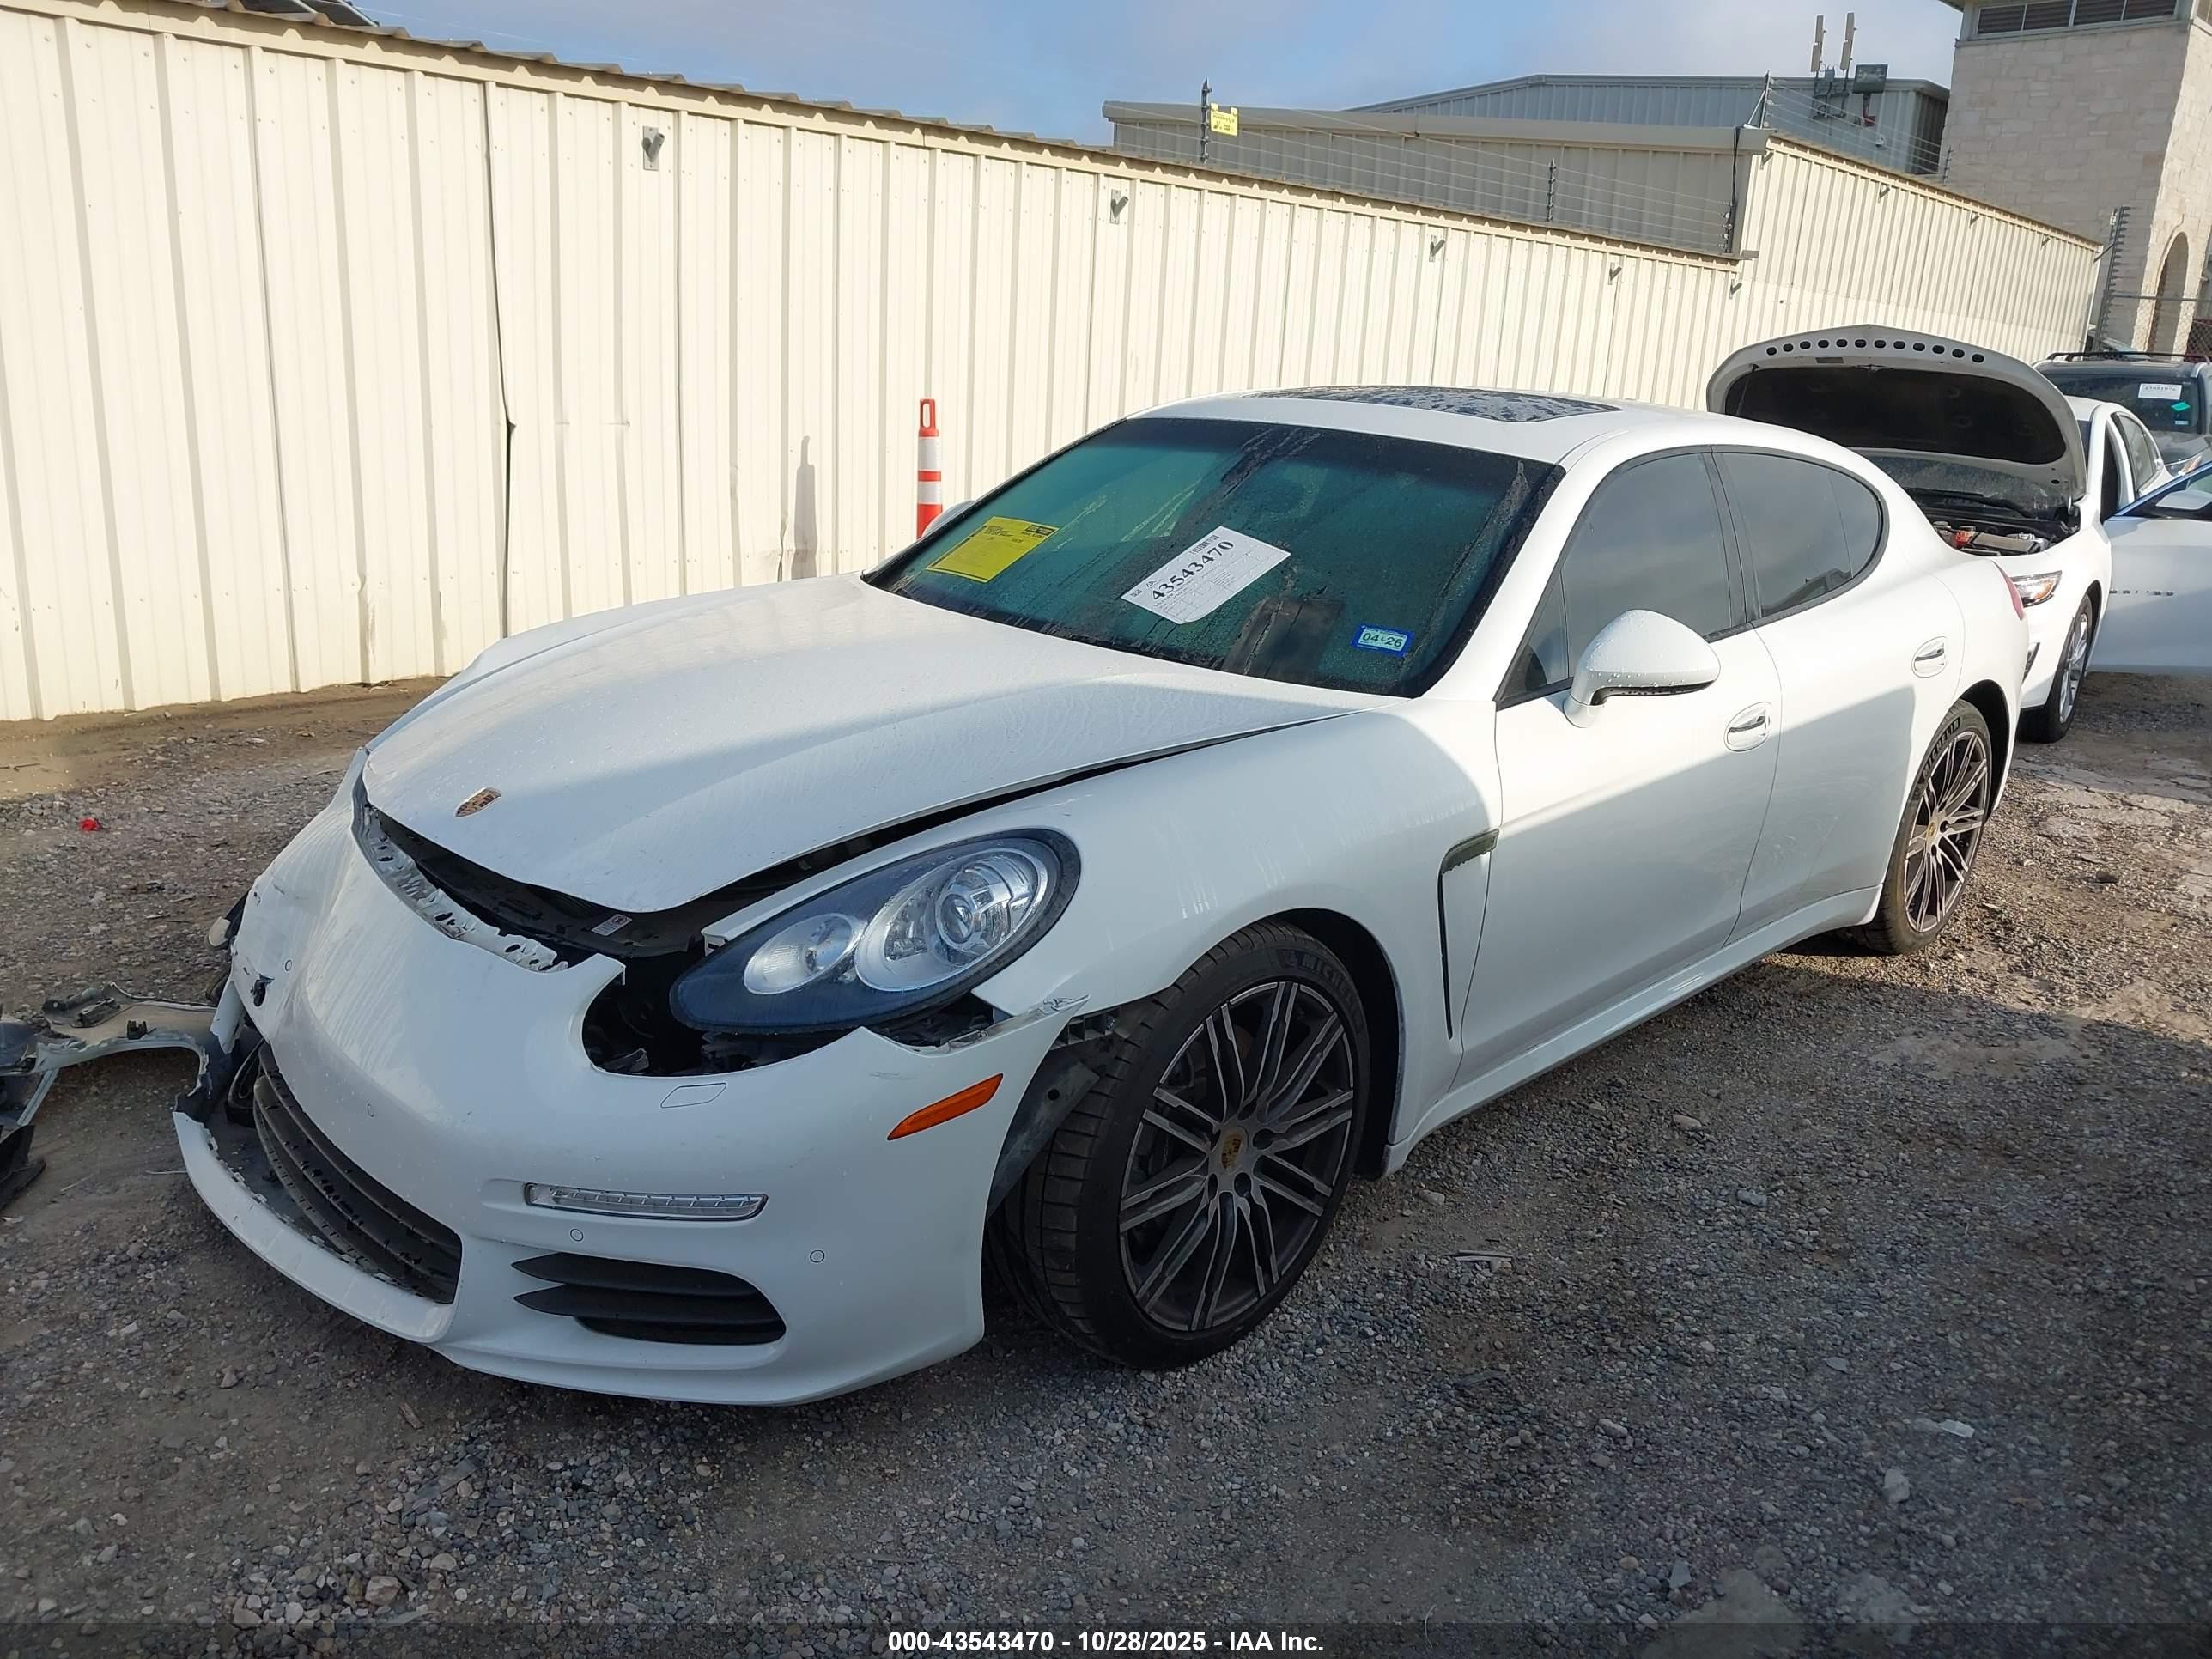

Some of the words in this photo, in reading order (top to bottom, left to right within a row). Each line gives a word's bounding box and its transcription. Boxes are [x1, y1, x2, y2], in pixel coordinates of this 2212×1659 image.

[1152, 541, 1234, 599] 43543470
[1363, 633, 1380, 642] 04
[1384, 636, 1403, 647] 26
[1921, 716, 1961, 778] MICHELIN
